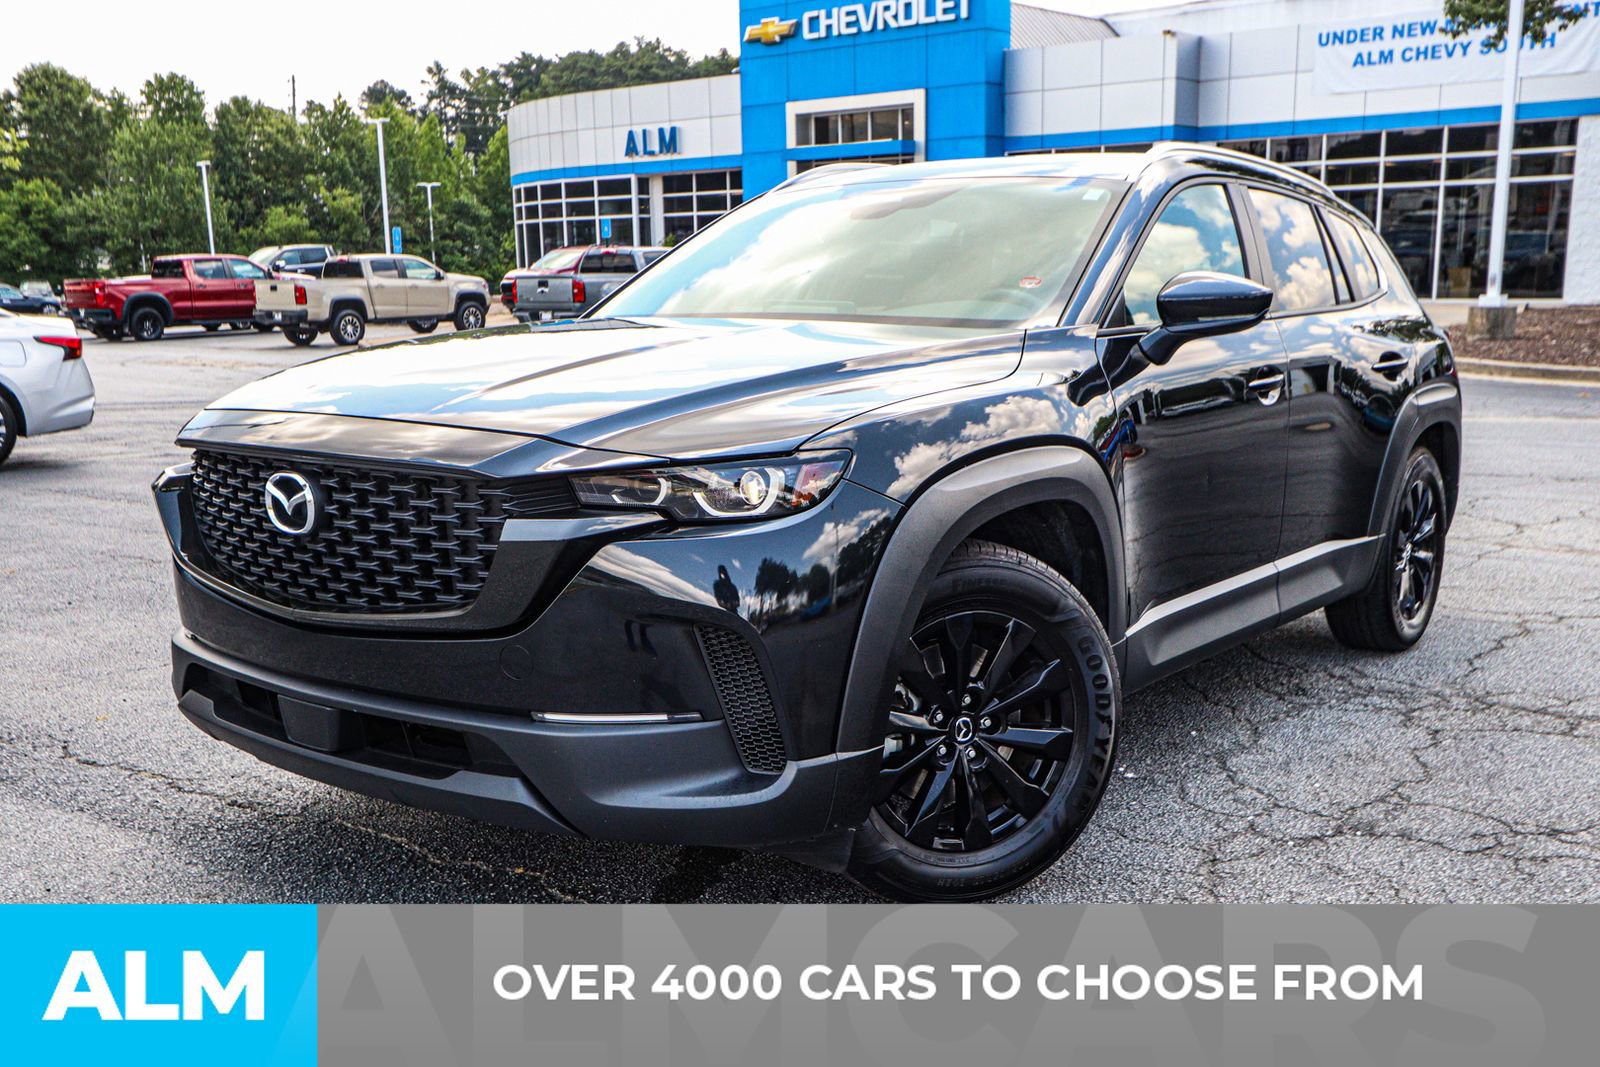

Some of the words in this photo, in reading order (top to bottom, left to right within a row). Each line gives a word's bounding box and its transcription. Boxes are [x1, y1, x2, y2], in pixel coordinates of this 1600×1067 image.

[802, 0, 969, 40] CHEVROLET
[1318, 26, 1385, 46] UNDER
[1391, 20, 1438, 39] NEW
[1352, 49, 1394, 67] ALM
[1401, 40, 1473, 62] CHEVY
[624, 126, 678, 157] ALM
